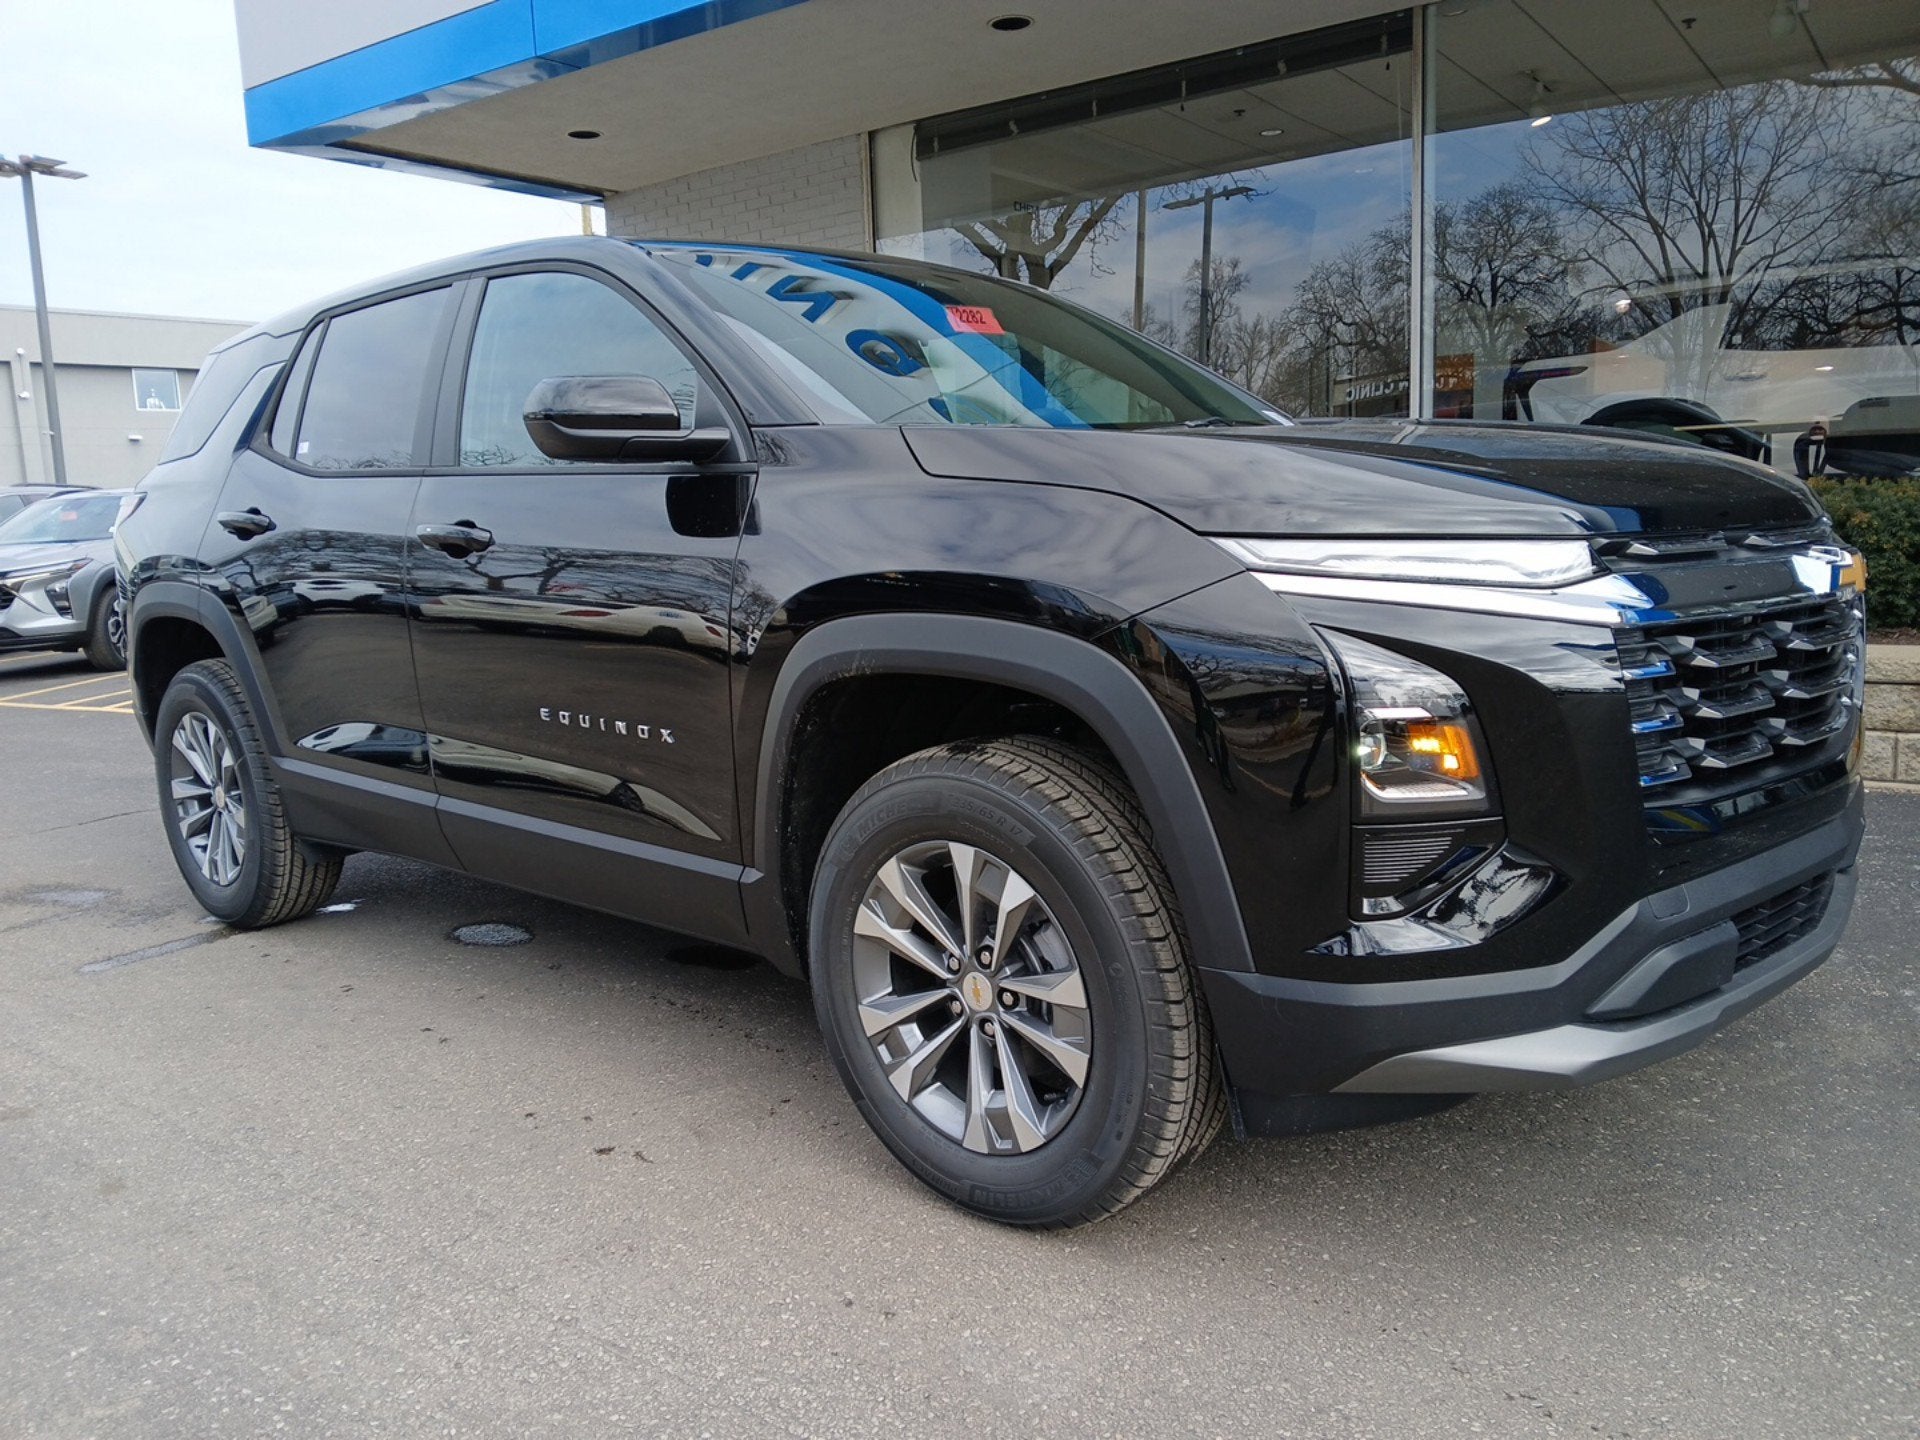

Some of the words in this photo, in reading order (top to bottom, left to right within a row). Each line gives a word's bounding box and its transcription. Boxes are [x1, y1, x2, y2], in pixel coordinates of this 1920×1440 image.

[540, 707, 676, 744] EQUINOX
[997, 815, 1007, 827] R
[1009, 824, 1023, 836] 17
